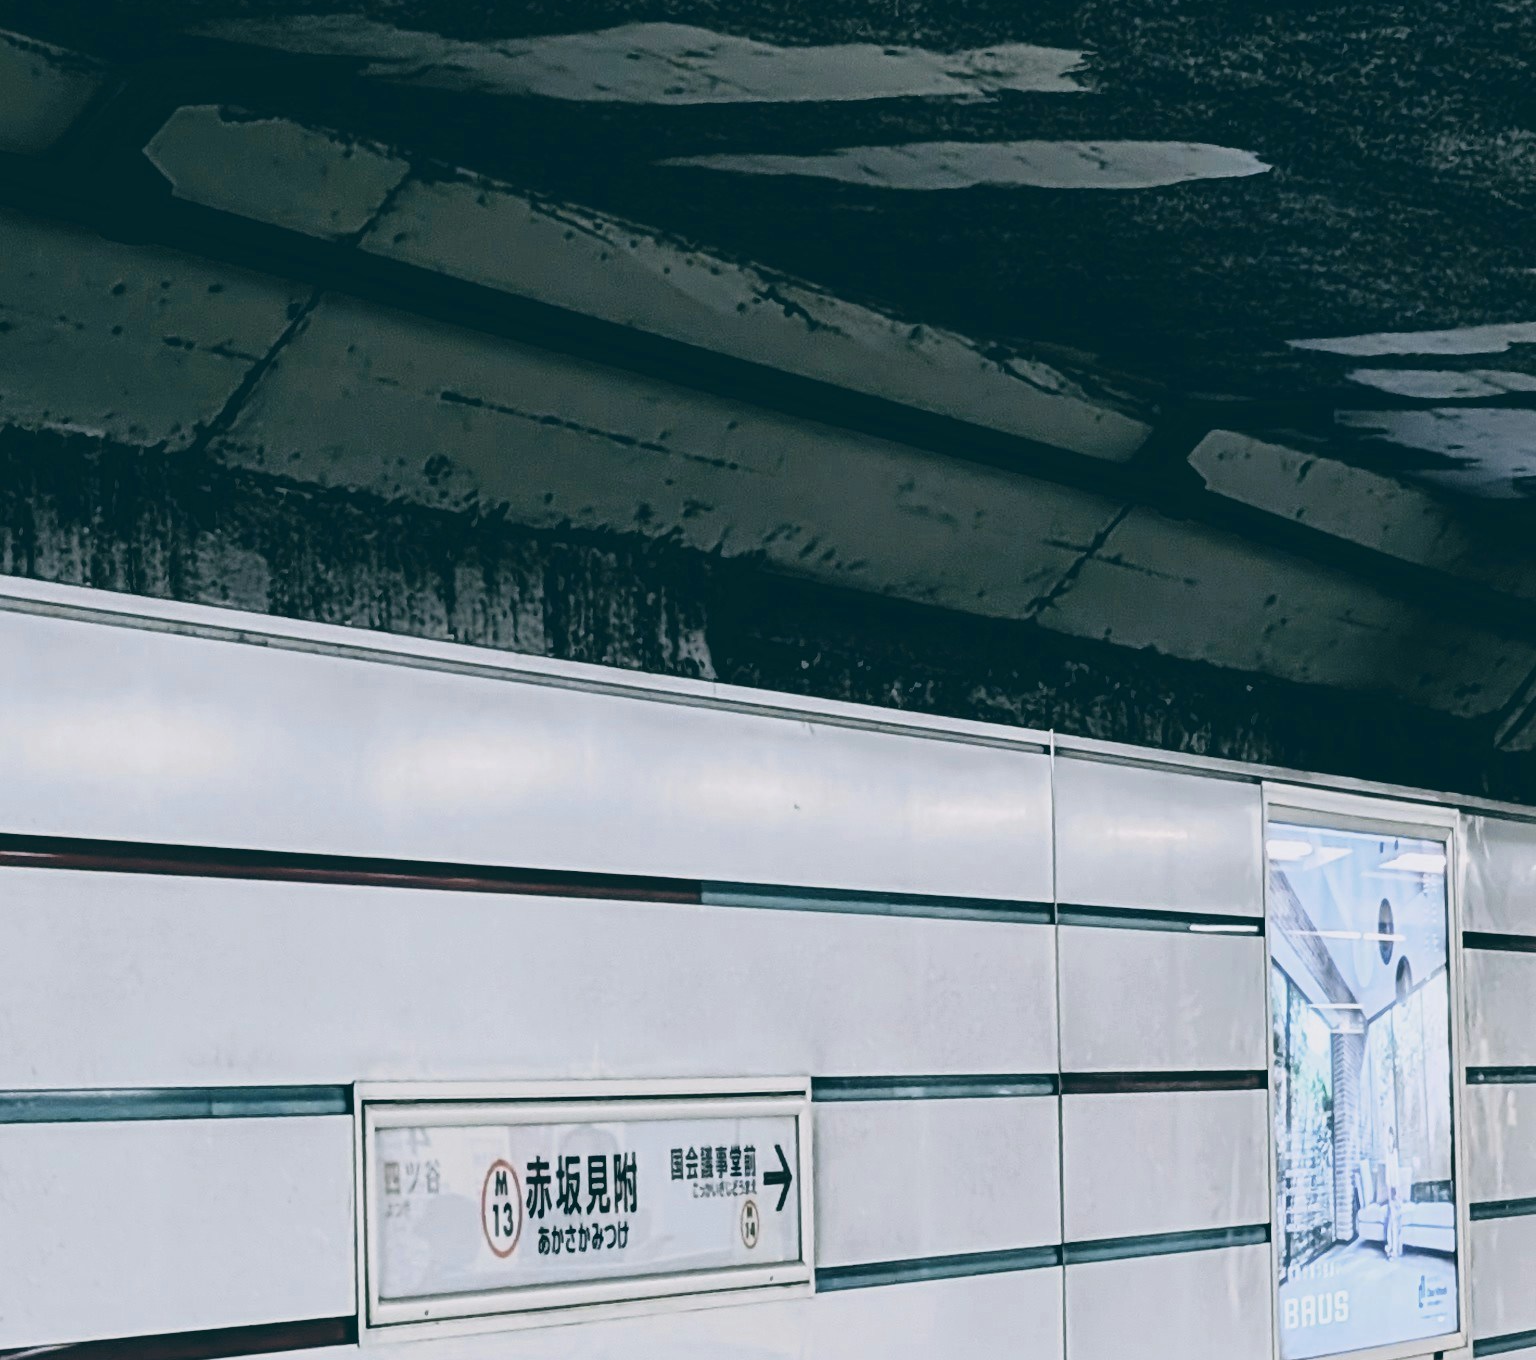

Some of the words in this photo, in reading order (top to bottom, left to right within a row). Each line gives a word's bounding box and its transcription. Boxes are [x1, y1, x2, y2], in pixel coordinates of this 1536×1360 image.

[495, 1170, 508, 1196] M
[525, 1151, 637, 1219] 赤坂見附
[493, 1202, 514, 1237] 13
[538, 1221, 629, 1255] あかさかみつけ
[1284, 1289, 1349, 1329] BAUS
